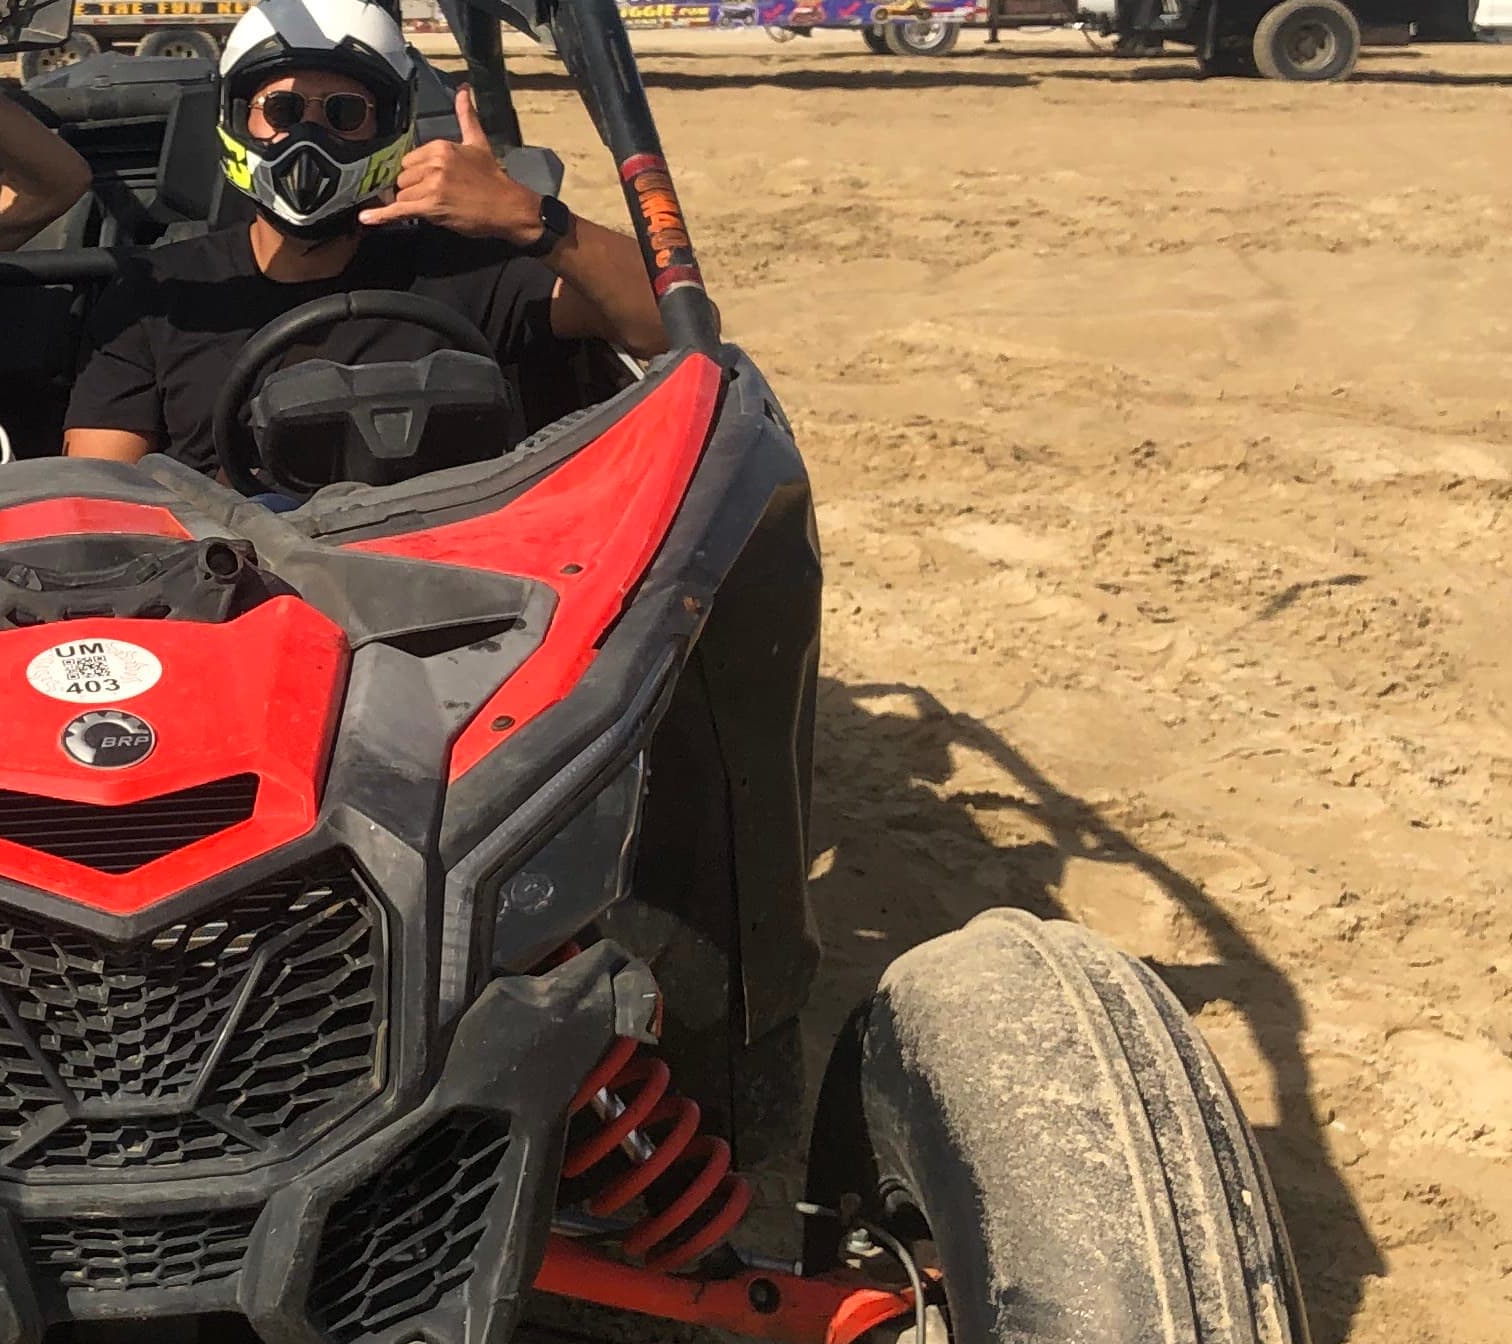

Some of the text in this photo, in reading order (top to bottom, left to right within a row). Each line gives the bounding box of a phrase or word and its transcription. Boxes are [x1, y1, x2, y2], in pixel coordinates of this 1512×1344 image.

[100, 1, 143, 15] THE
[157, 1, 203, 15] FUN
[55, 642, 105, 658] UM
[66, 678, 121, 694] 403
[101, 735, 150, 748] BRP
